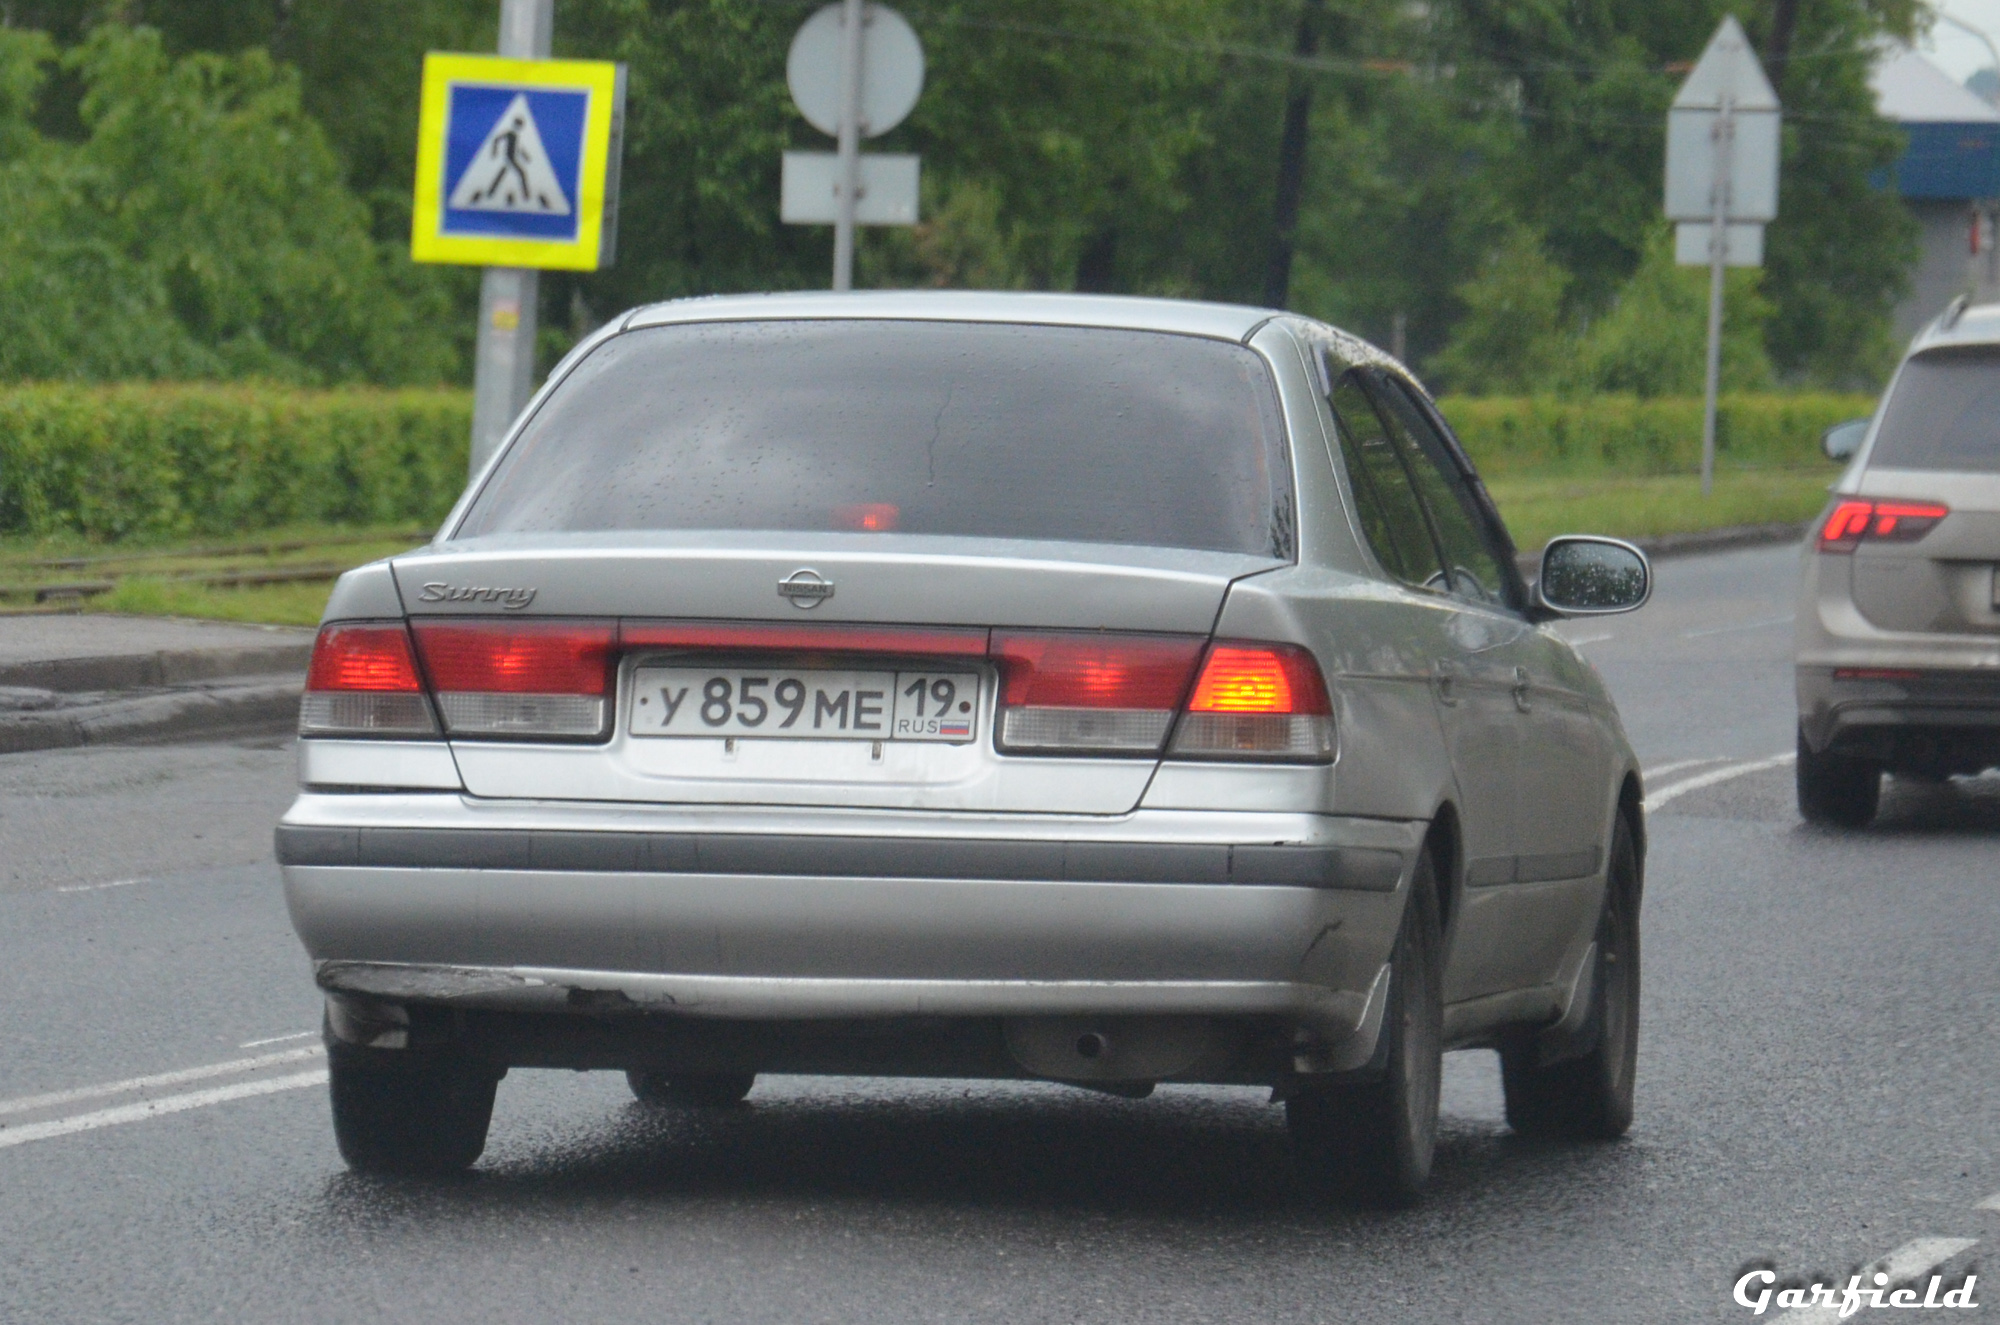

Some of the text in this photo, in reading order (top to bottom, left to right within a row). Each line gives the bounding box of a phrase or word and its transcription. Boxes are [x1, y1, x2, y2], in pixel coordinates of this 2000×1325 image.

[418, 582, 537, 609] Sunny
[783, 583, 827, 593] NISSAN
[904, 679, 956, 717] 19
[898, 719, 938, 734] RUS
